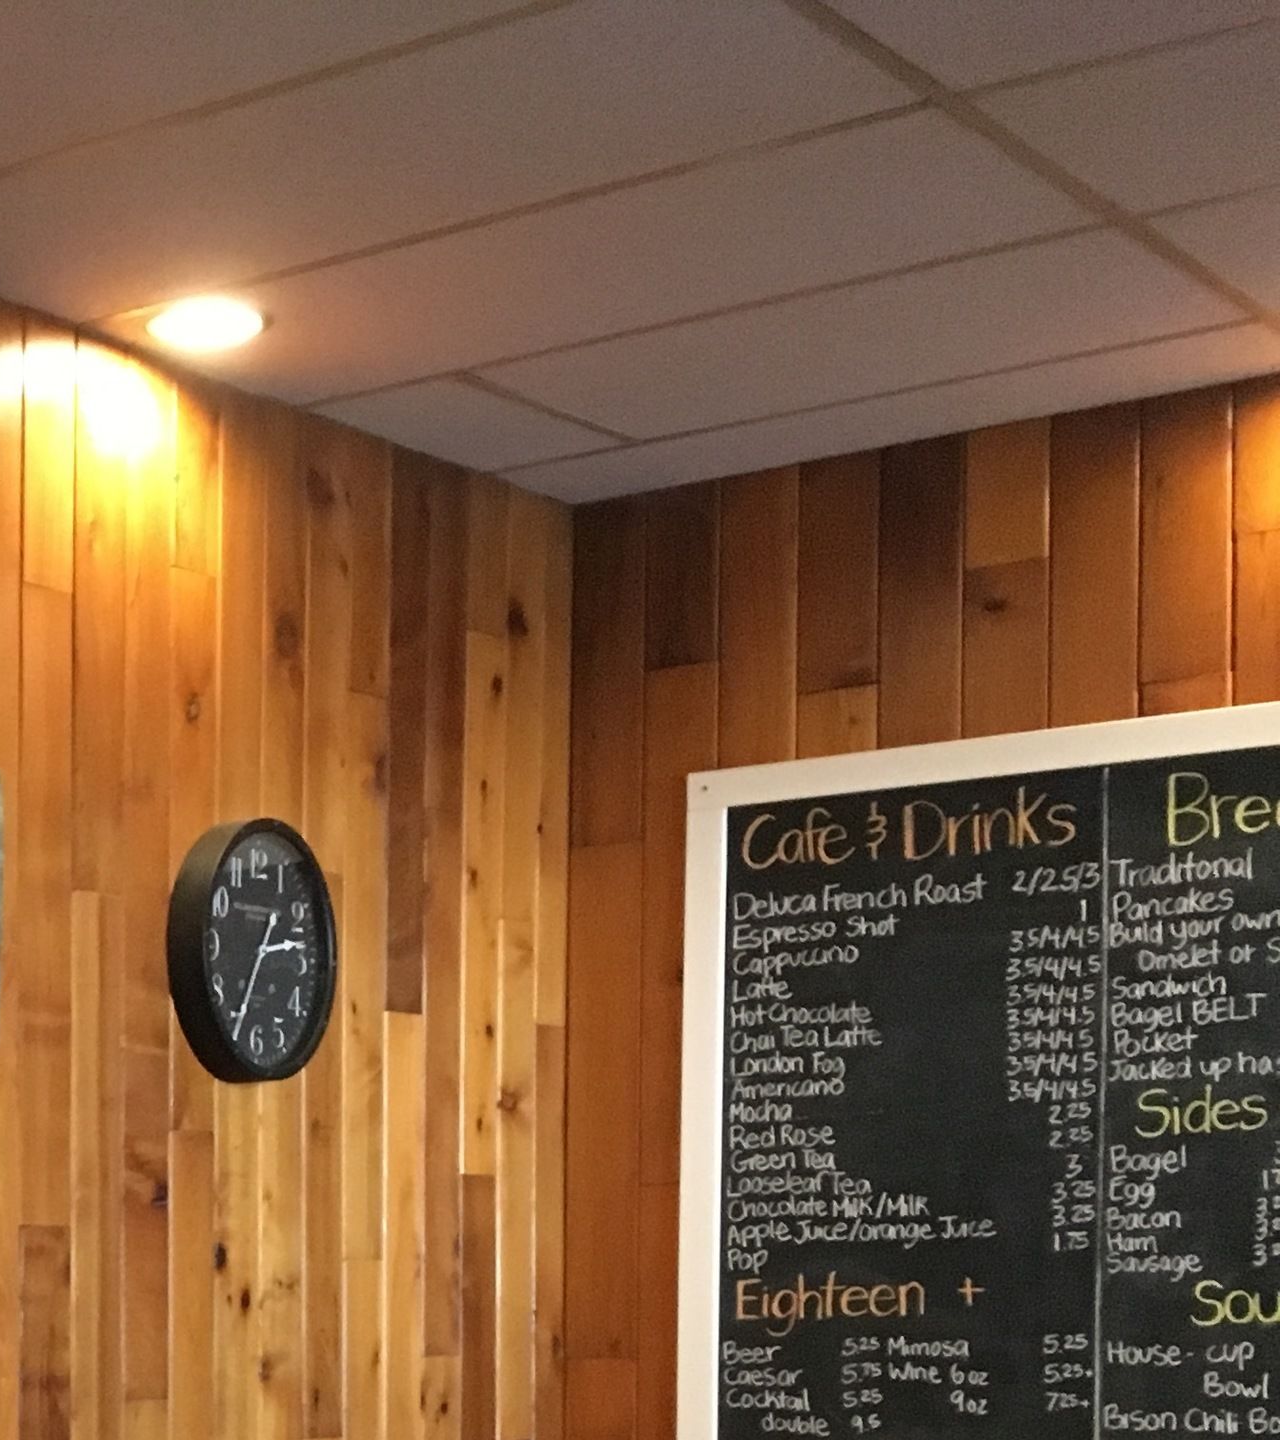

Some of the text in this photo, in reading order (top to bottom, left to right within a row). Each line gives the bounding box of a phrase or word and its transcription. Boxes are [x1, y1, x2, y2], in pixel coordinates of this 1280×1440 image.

[1167, 771, 1280, 847] Bre
[742, 807, 856, 870] Cafe
[903, 786, 1078, 862] Drinks
[230, 856, 242, 889] 11
[251, 848, 268, 881] 12
[212, 885, 229, 919] 10
[733, 892, 816, 921] Deluca
[823, 883, 908, 911] French
[914, 873, 988, 906] Roast
[1112, 887, 1234, 923] Pancakes
[733, 920, 837, 953] Espresso
[845, 913, 901, 938] Shot
[1109, 919, 1164, 949] Build
[1169, 914, 1226, 950] your
[1138, 938, 1223, 973] Omelet
[1229, 943, 1257, 964] or
[287, 985, 301, 1018] 4
[733, 975, 794, 1003] Latte
[1112, 970, 1228, 1001] Sandwich
[730, 1003, 767, 1028] Hot
[768, 1000, 873, 1026] Chocolate
[1111, 991, 1269, 1034] Bagel BELT
[249, 1023, 264, 1057] 6
[730, 1030, 776, 1054] Chai
[780, 1023, 820, 1049] Tea
[824, 1024, 884, 1049] Latte
[1113, 1025, 1199, 1059] Pocket
[729, 1050, 805, 1077] London
[812, 1050, 847, 1080] Fog
[1108, 1054, 1192, 1083] Jacked
[1199, 1056, 1233, 1083] up
[730, 1077, 846, 1101] Americano
[729, 1099, 794, 1124] Mocha
[1134, 1083, 1269, 1139] Sides
[729, 1123, 776, 1150] Red
[781, 1123, 837, 1148] Rose
[730, 1149, 797, 1174] Green
[801, 1148, 837, 1171] Tea
[831, 1170, 873, 1197] Tea
[1065, 1153, 1084, 1180] 3
[1109, 1144, 1187, 1181] Bagel
[727, 1194, 829, 1222] Chocolate
[1108, 1174, 1156, 1209] Egg
[727, 1218, 793, 1248] Apple
[938, 1215, 998, 1240] Juice
[1105, 1206, 1182, 1231] Bacon
[1105, 1230, 1159, 1254] Ham
[727, 1247, 769, 1275] Pop
[1105, 1250, 1205, 1283] Sausage
[735, 1270, 926, 1338] Eighteen
[722, 1339, 783, 1365] Beer
[888, 1335, 971, 1358] Mimosa
[723, 1365, 804, 1387] Caesar
[889, 1361, 943, 1384] Wine
[1203, 1370, 1270, 1400] Bowl
[726, 1387, 812, 1413] Cocktail
[761, 1411, 831, 1437] double
[1104, 1402, 1178, 1432] Bison
